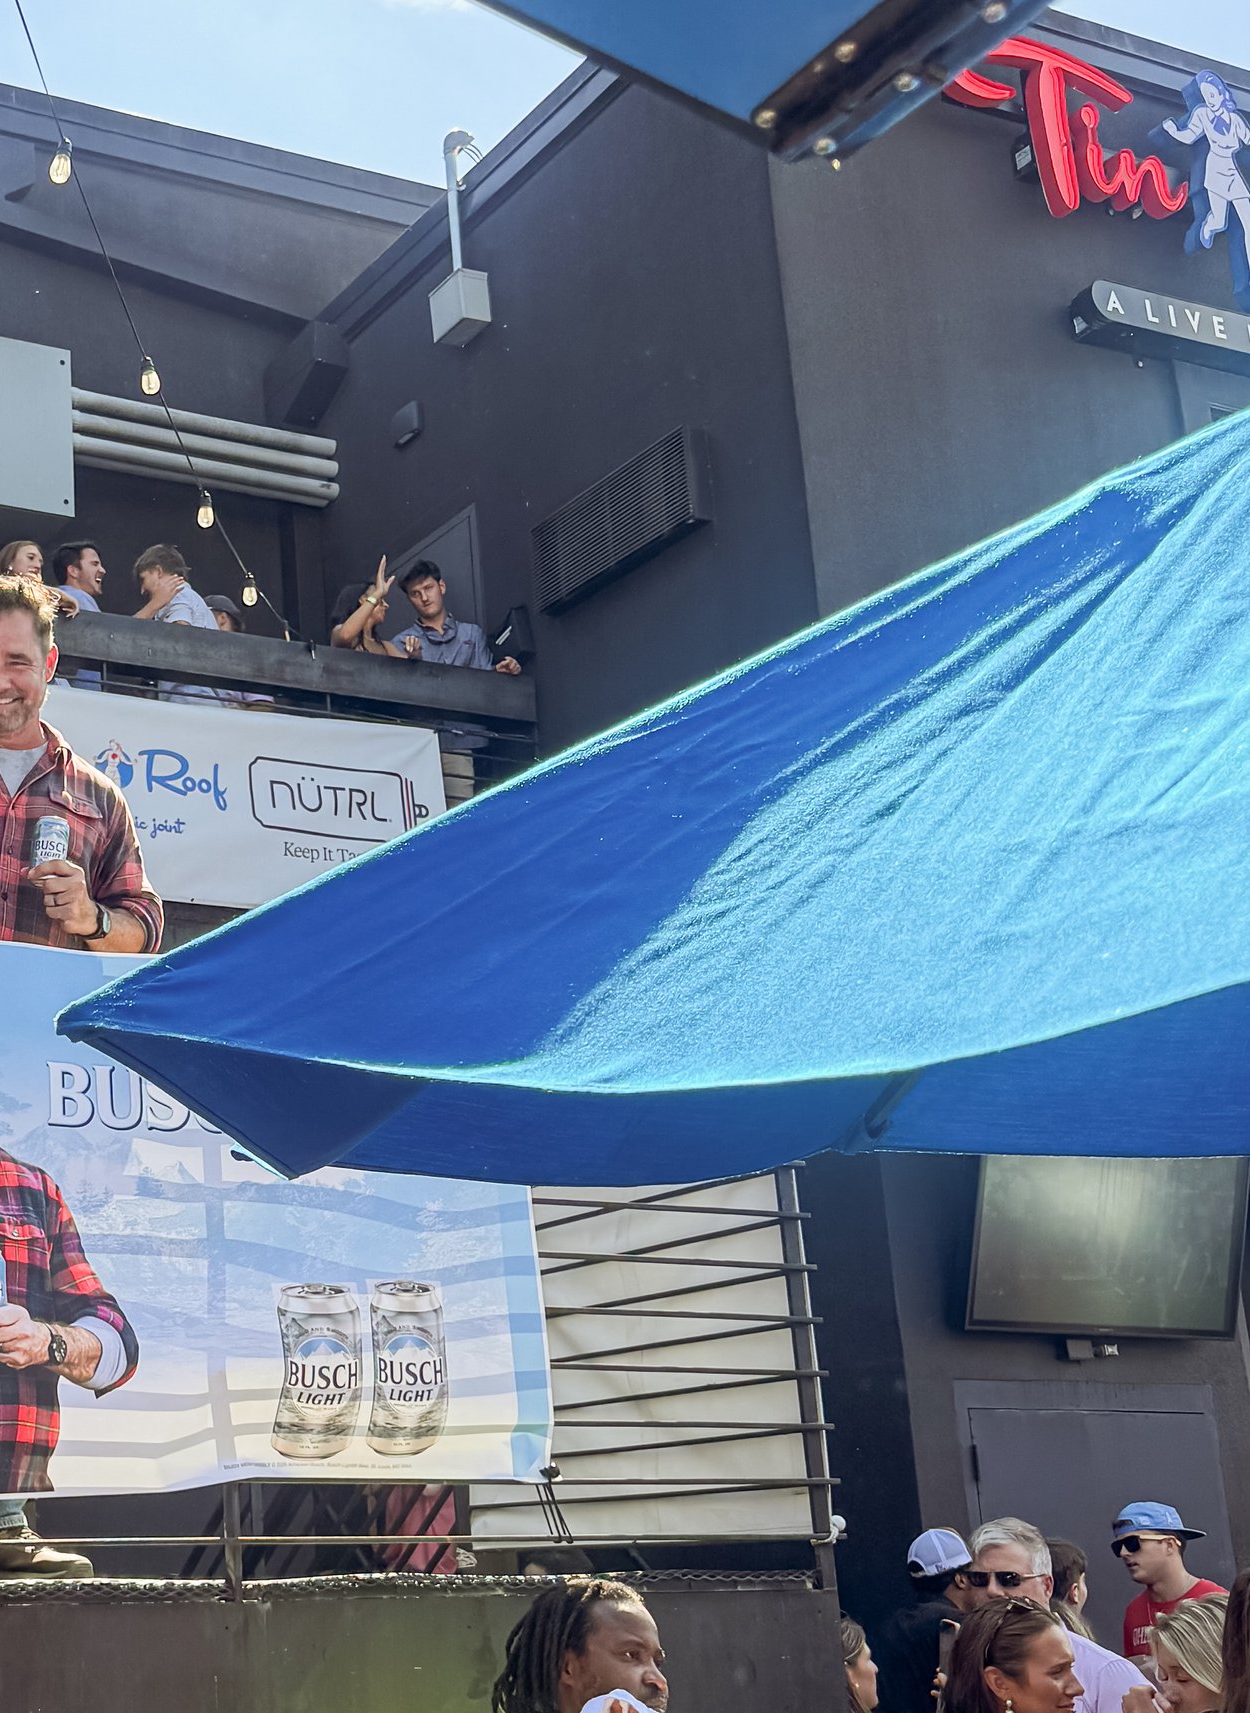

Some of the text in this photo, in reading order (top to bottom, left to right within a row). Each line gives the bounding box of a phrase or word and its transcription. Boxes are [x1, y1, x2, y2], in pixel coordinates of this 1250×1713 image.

[942, 36, 1188, 220] Tin
[1106, 290, 1125, 315] A
[1144, 299, 1228, 340] LIVE
[137, 749, 228, 812] Roof
[150, 818, 186, 839] joint
[283, 842, 361, 863] Keep It Ta
[46, 1061, 223, 1135] BUS
[288, 1360, 359, 1390] BUSCH
[378, 1357, 444, 1386] BUSCH
[297, 1391, 346, 1406] LIGHT
[389, 1388, 434, 1402] LIGHT
